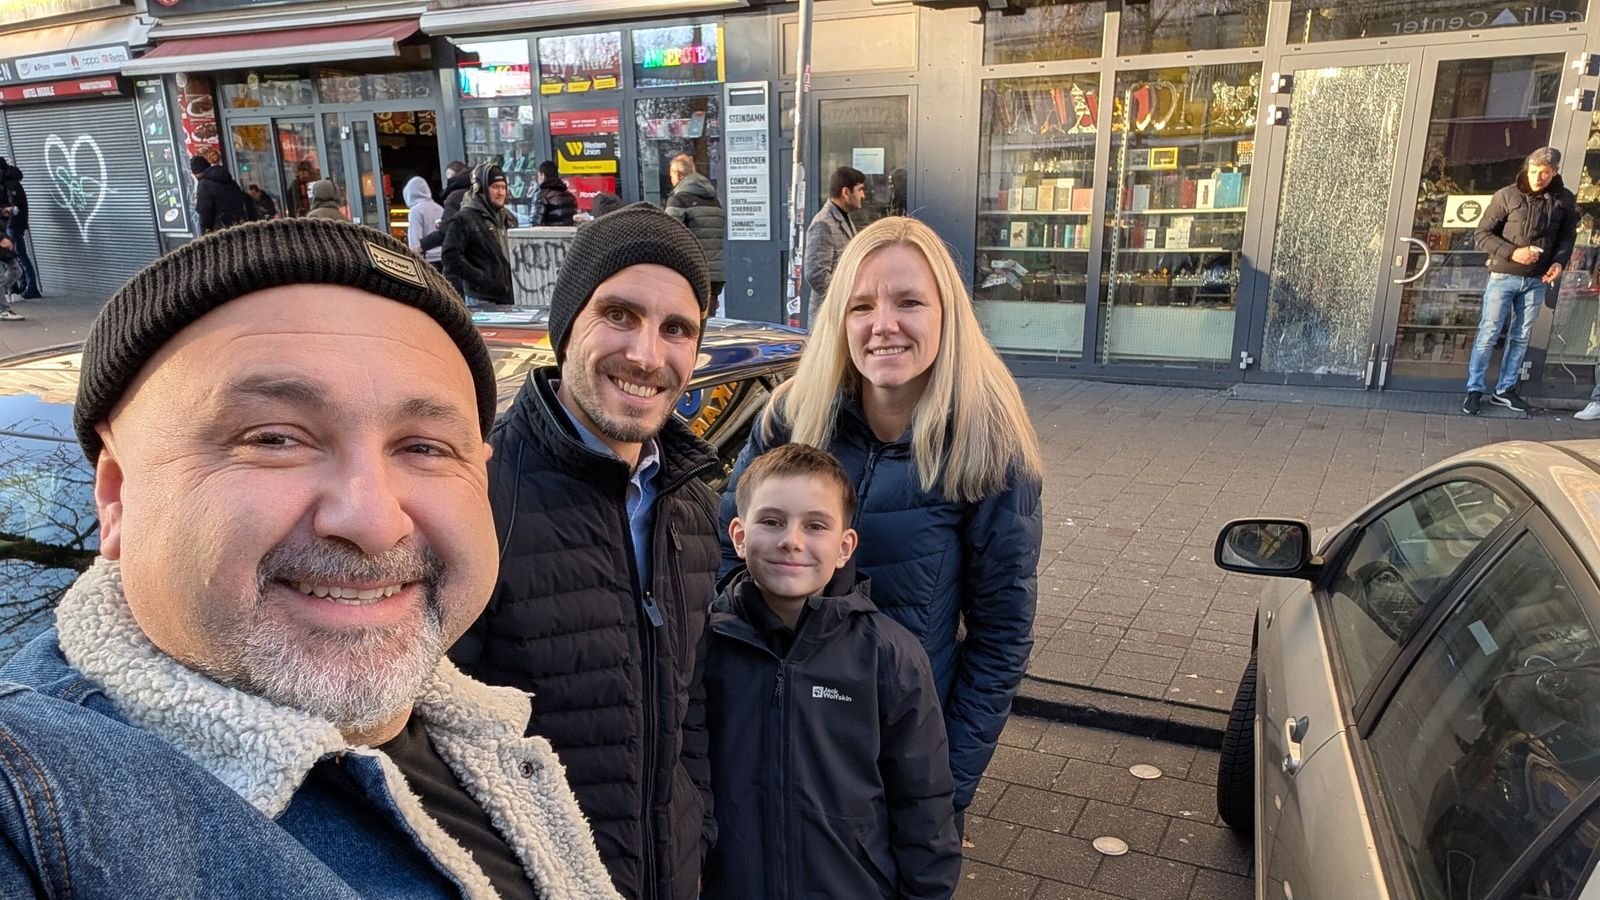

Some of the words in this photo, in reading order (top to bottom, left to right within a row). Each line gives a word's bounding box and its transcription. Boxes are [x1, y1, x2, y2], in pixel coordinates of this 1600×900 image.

[728, 113, 766, 123] STEINDAMM
[761, 134, 767, 144] 3
[583, 141, 607, 149] Western
[729, 156, 766, 165] FREIZEICHEN
[729, 177, 758, 185] CONPLAN
[731, 220, 755, 228] ZAHNARZT
[823, 692, 852, 701] Wolfskin
